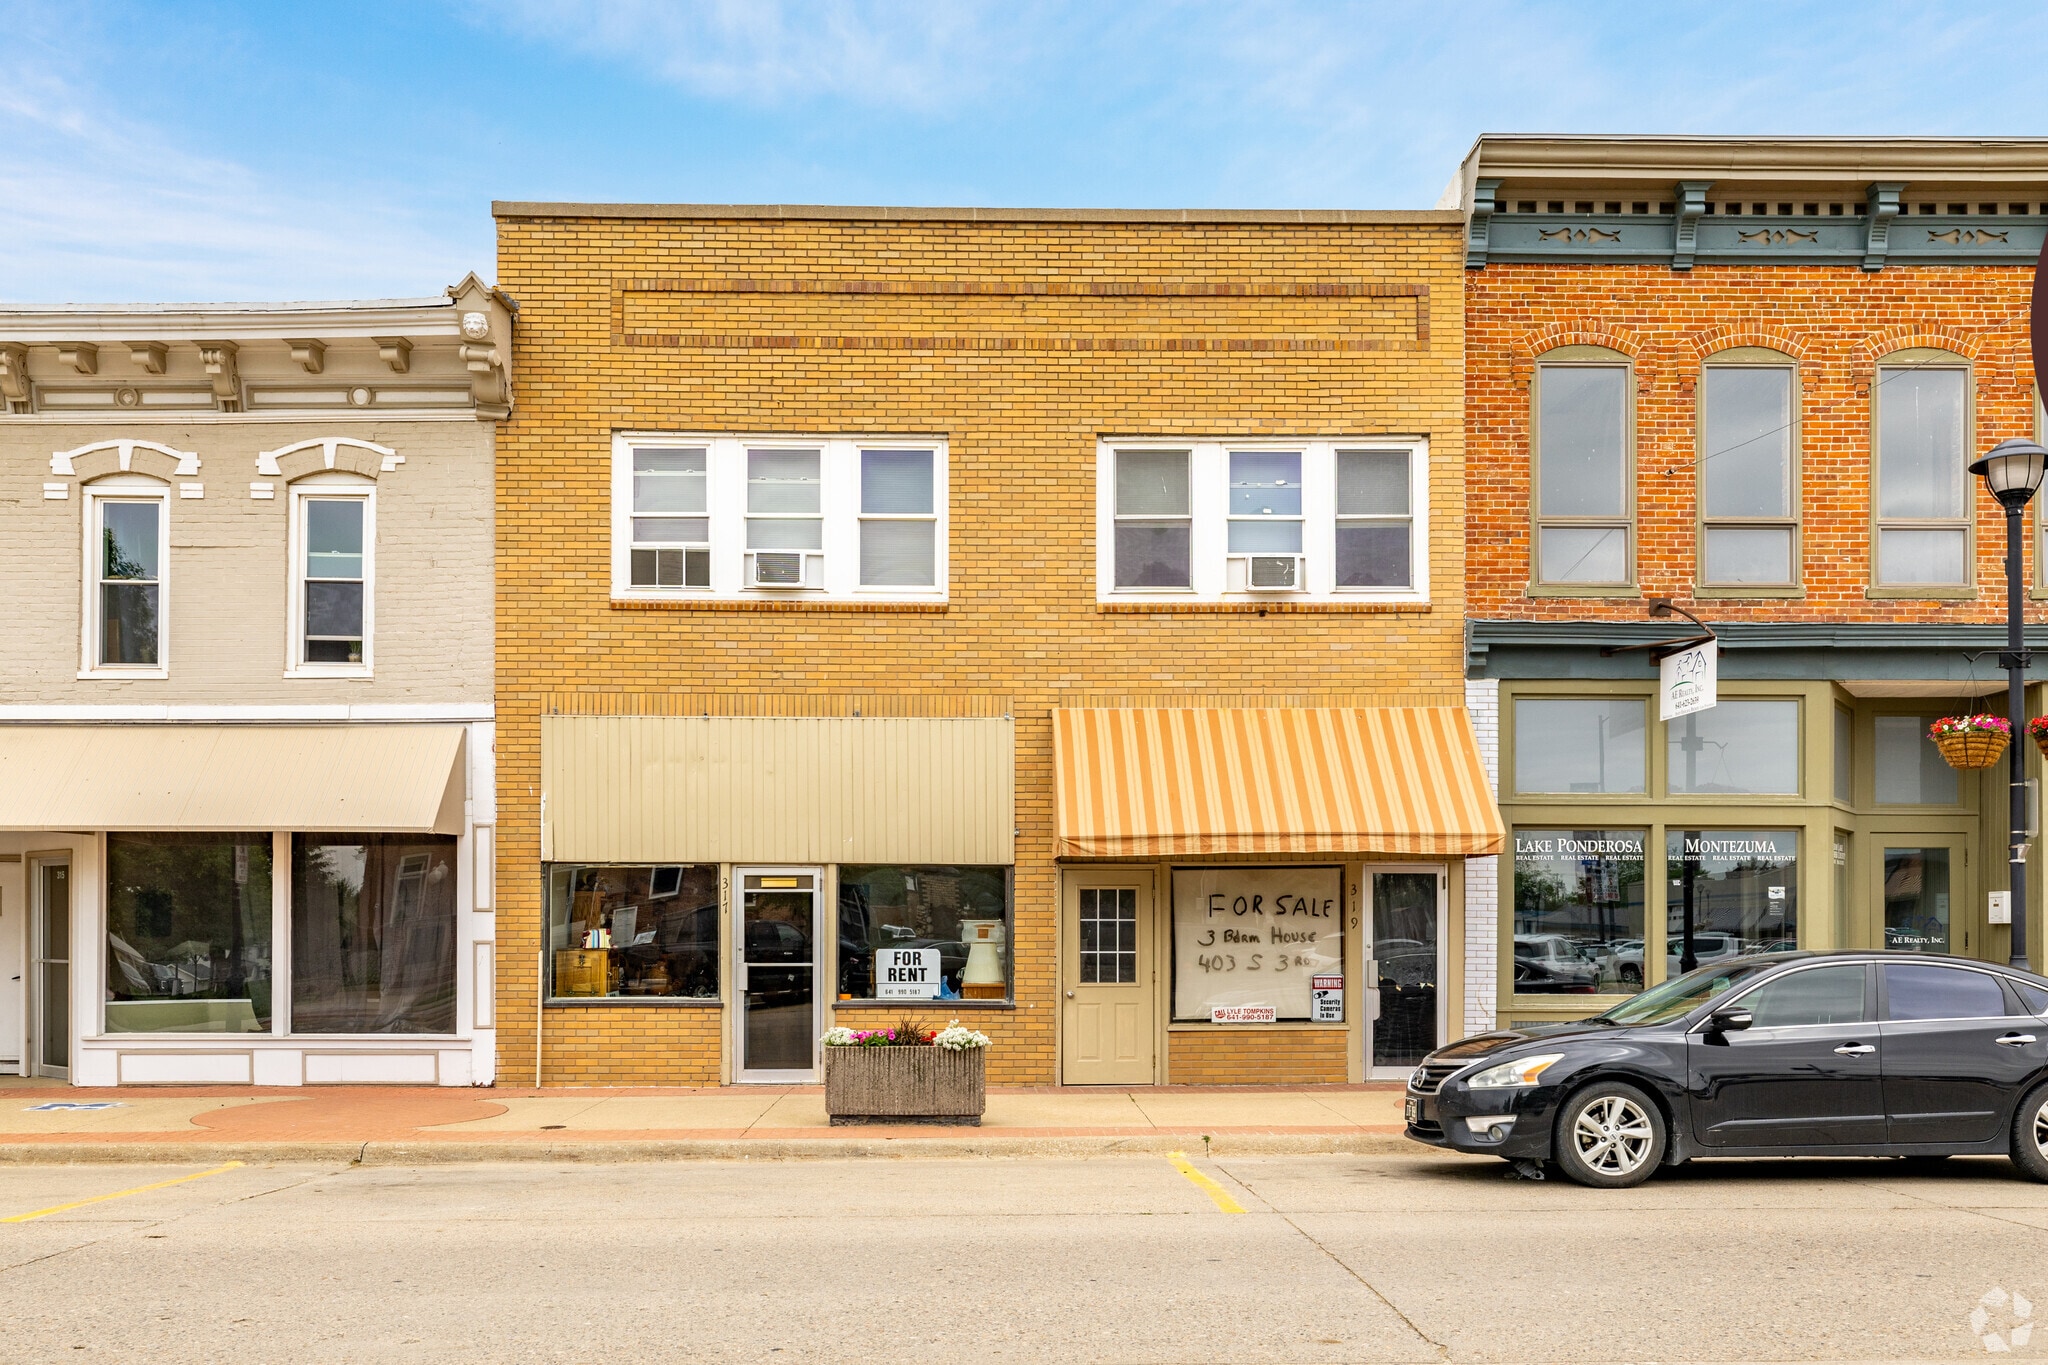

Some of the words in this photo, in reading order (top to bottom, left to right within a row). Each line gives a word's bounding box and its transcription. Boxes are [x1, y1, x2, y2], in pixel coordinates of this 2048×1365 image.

[1515, 838, 1553, 853] LAKE
[1557, 838, 1643, 853] PONDEROSA
[1685, 838, 1777, 853] MONTEZUMA
[56, 871, 65, 879] 315
[1209, 893, 1263, 918] FOR
[1275, 894, 1334, 918] SALE
[1350, 883, 1358, 930] 319
[1197, 929, 1215, 946] 3
[1892, 936, 1903, 944] AE
[893, 951, 922, 966] FOR
[1198, 954, 1236, 973] 403
[1246, 953, 1263, 970] S
[887, 967, 928, 982] RENT
[1314, 978, 1342, 988] WARNING
[1320, 998, 1341, 1006] Security
